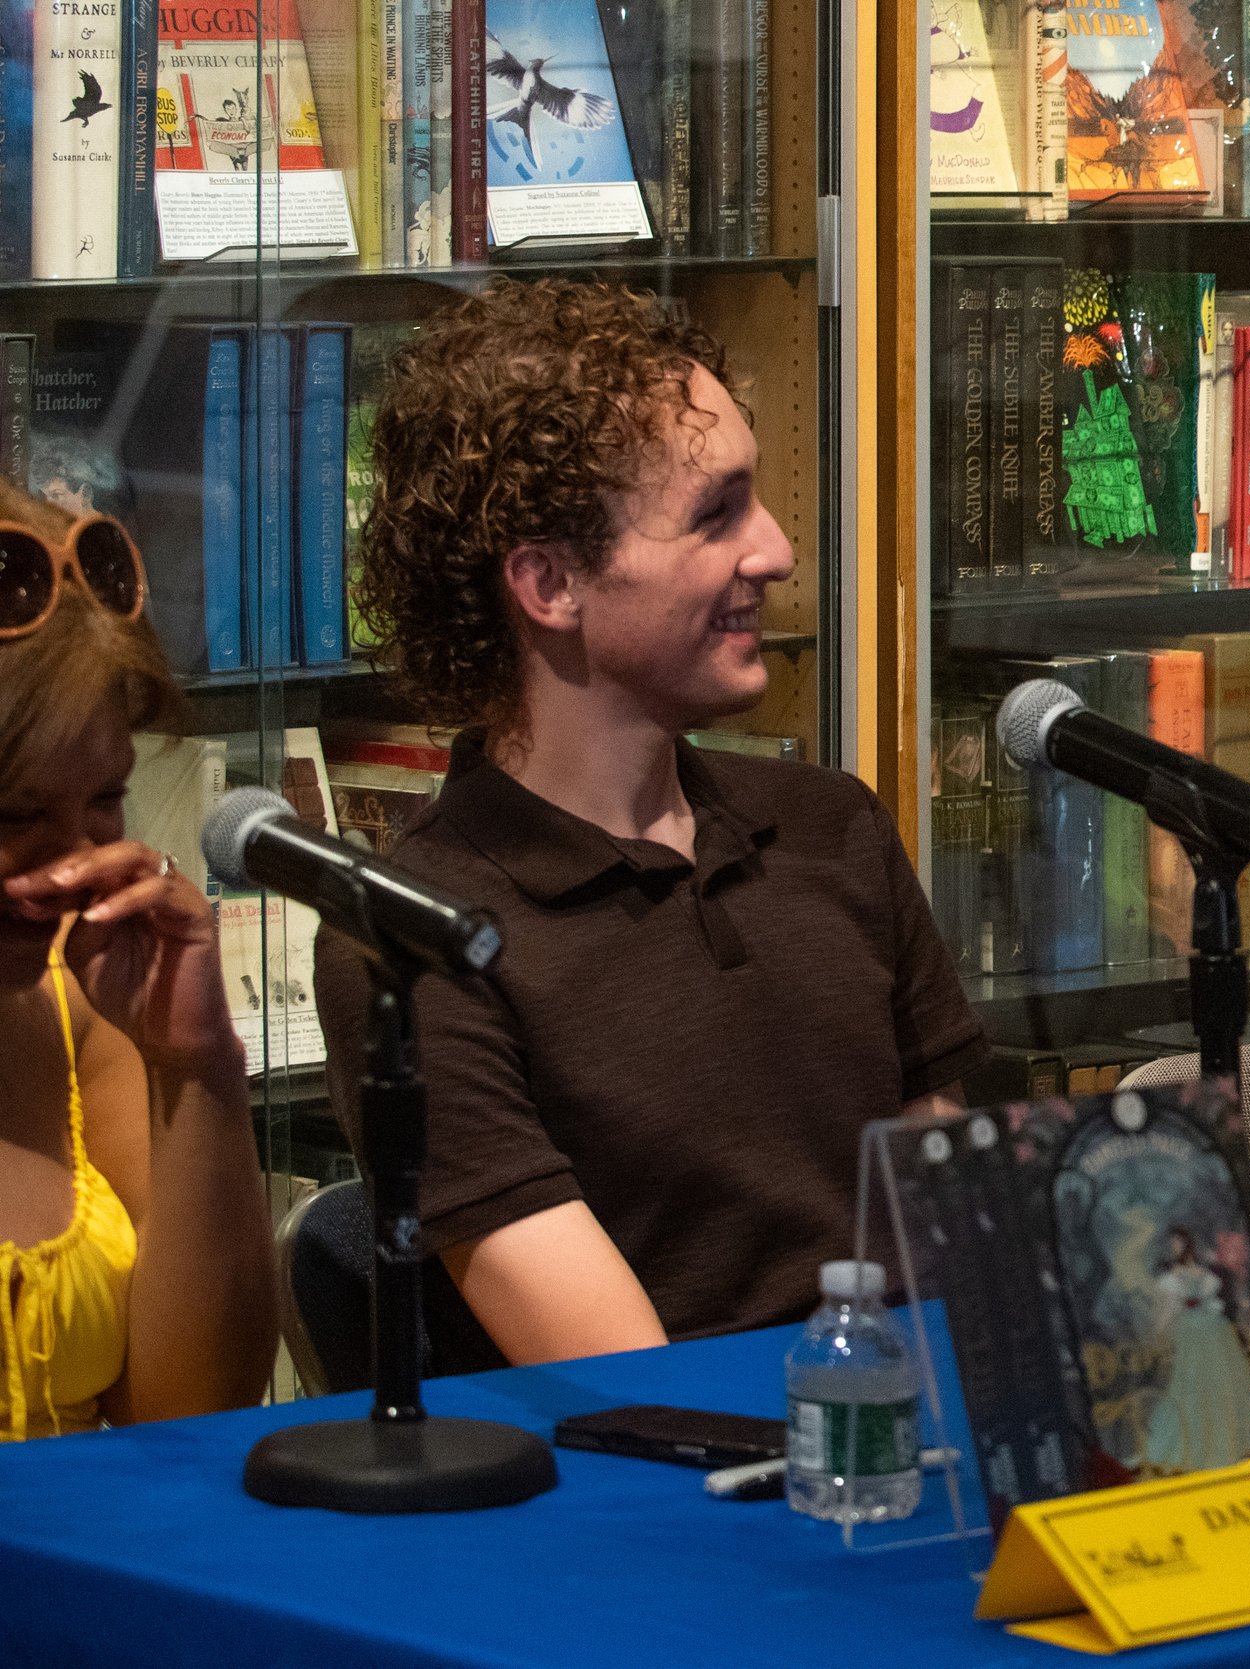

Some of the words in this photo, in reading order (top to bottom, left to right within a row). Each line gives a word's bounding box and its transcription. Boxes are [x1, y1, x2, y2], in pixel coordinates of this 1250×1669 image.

[52, 3, 117, 16] STRANGE
[386, 5, 397, 35] PRINCE
[431, 11, 443, 23] OF
[136, 48, 148, 58] A
[386, 36, 397, 45] IN
[414, 15, 426, 56] BURNING
[51, 49, 65, 59] Mr
[68, 49, 117, 59] NORRELL
[171, 56, 230, 68] BEVERLY
[235, 55, 287, 68] CLEARY
[386, 46, 397, 81] WAITING
[431, 46, 443, 84] SPIRITS
[136, 58, 148, 91] GIRL
[415, 57, 426, 88] LANDS
[470, 38, 481, 129] CATCHING
[136, 96, 148, 135] FROM
[157, 96, 176, 111] BUS
[157, 112, 179, 126] STOP
[81, 138, 90, 149] by
[210, 131, 250, 141] ECONOMY
[388, 123, 398, 166] Christopher
[52, 152, 86, 162] Susanna
[88, 152, 112, 162] Clarke
[135, 136, 148, 195] YAMHILL
[471, 138, 481, 179] FIRE
[967, 318, 983, 362] THE
[1004, 316, 1020, 361] THE
[1040, 316, 1055, 359] THE
[36, 392, 101, 411] Hatcher
[965, 367, 984, 453] GOLDEN
[1004, 365, 1020, 438] SUBTLE
[1037, 352, 1055, 447] AMBER
[1001, 443, 1021, 504] KNIFE
[963, 456, 983, 553] COMPASS
[1036, 443, 1056, 546] SPYGLASS
